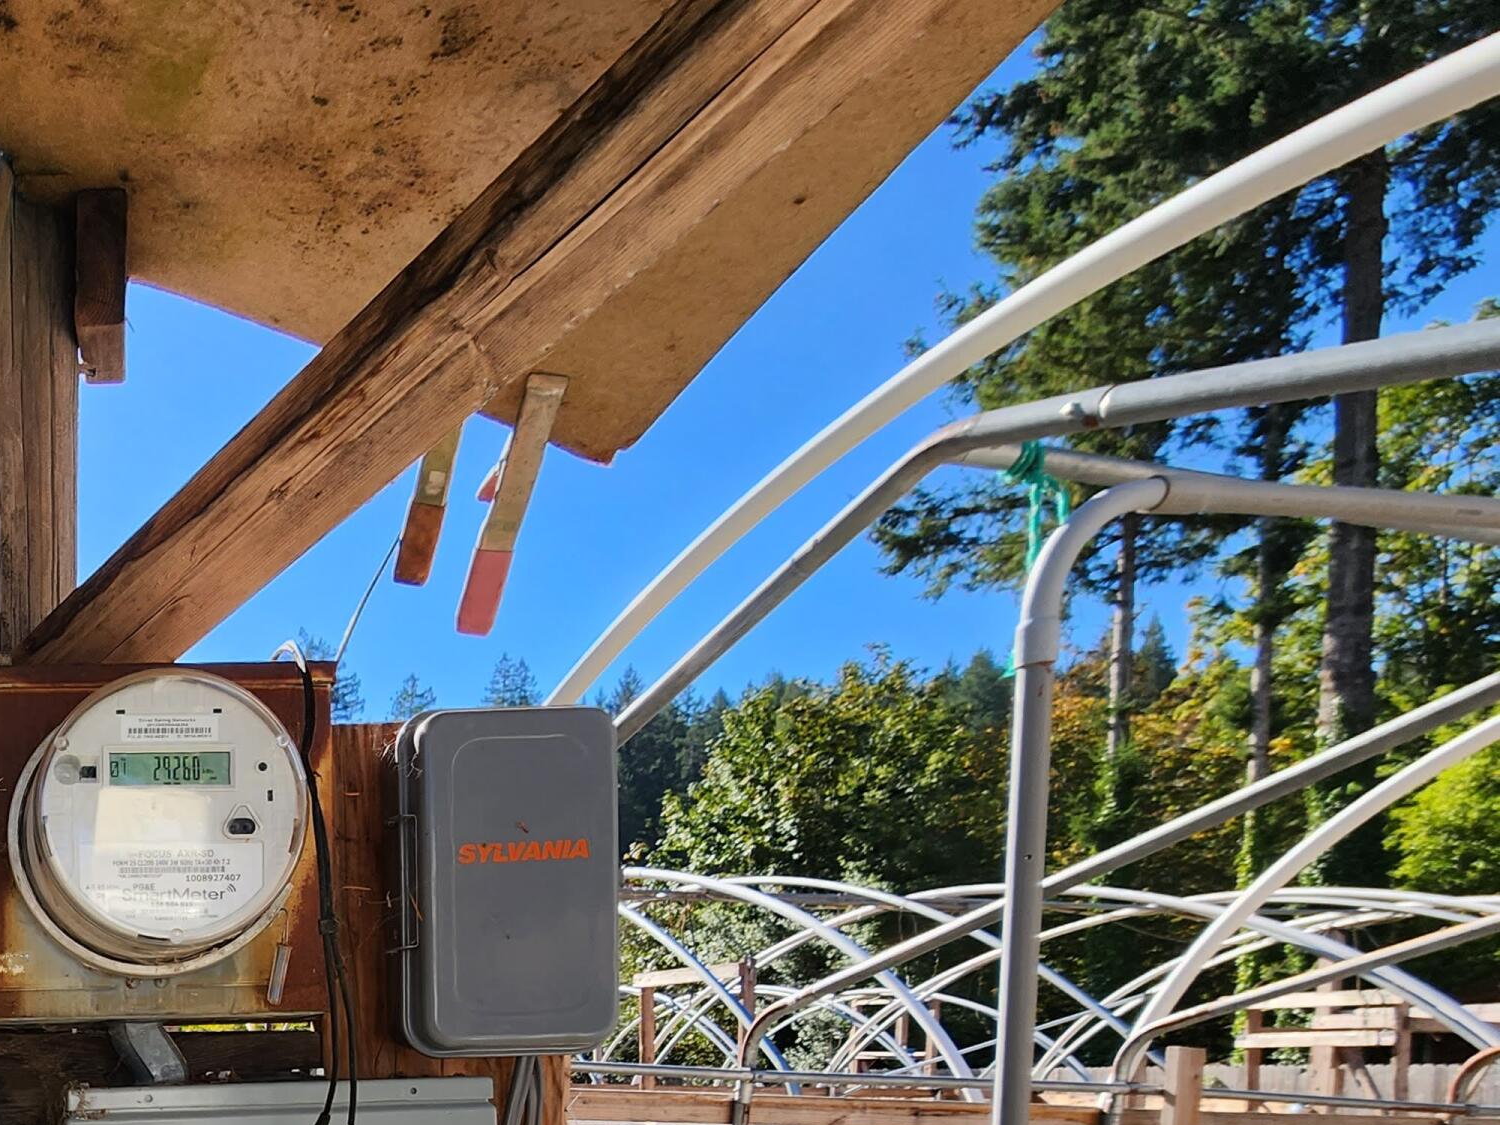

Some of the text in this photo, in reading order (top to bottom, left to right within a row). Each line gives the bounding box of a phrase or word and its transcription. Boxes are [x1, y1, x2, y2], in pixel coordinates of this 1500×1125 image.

[153, 755, 200, 781] 29260
[458, 838, 590, 864] SYLVANIA
[186, 873, 241, 882] 1008927407
[122, 887, 226, 901] SmartMeter
